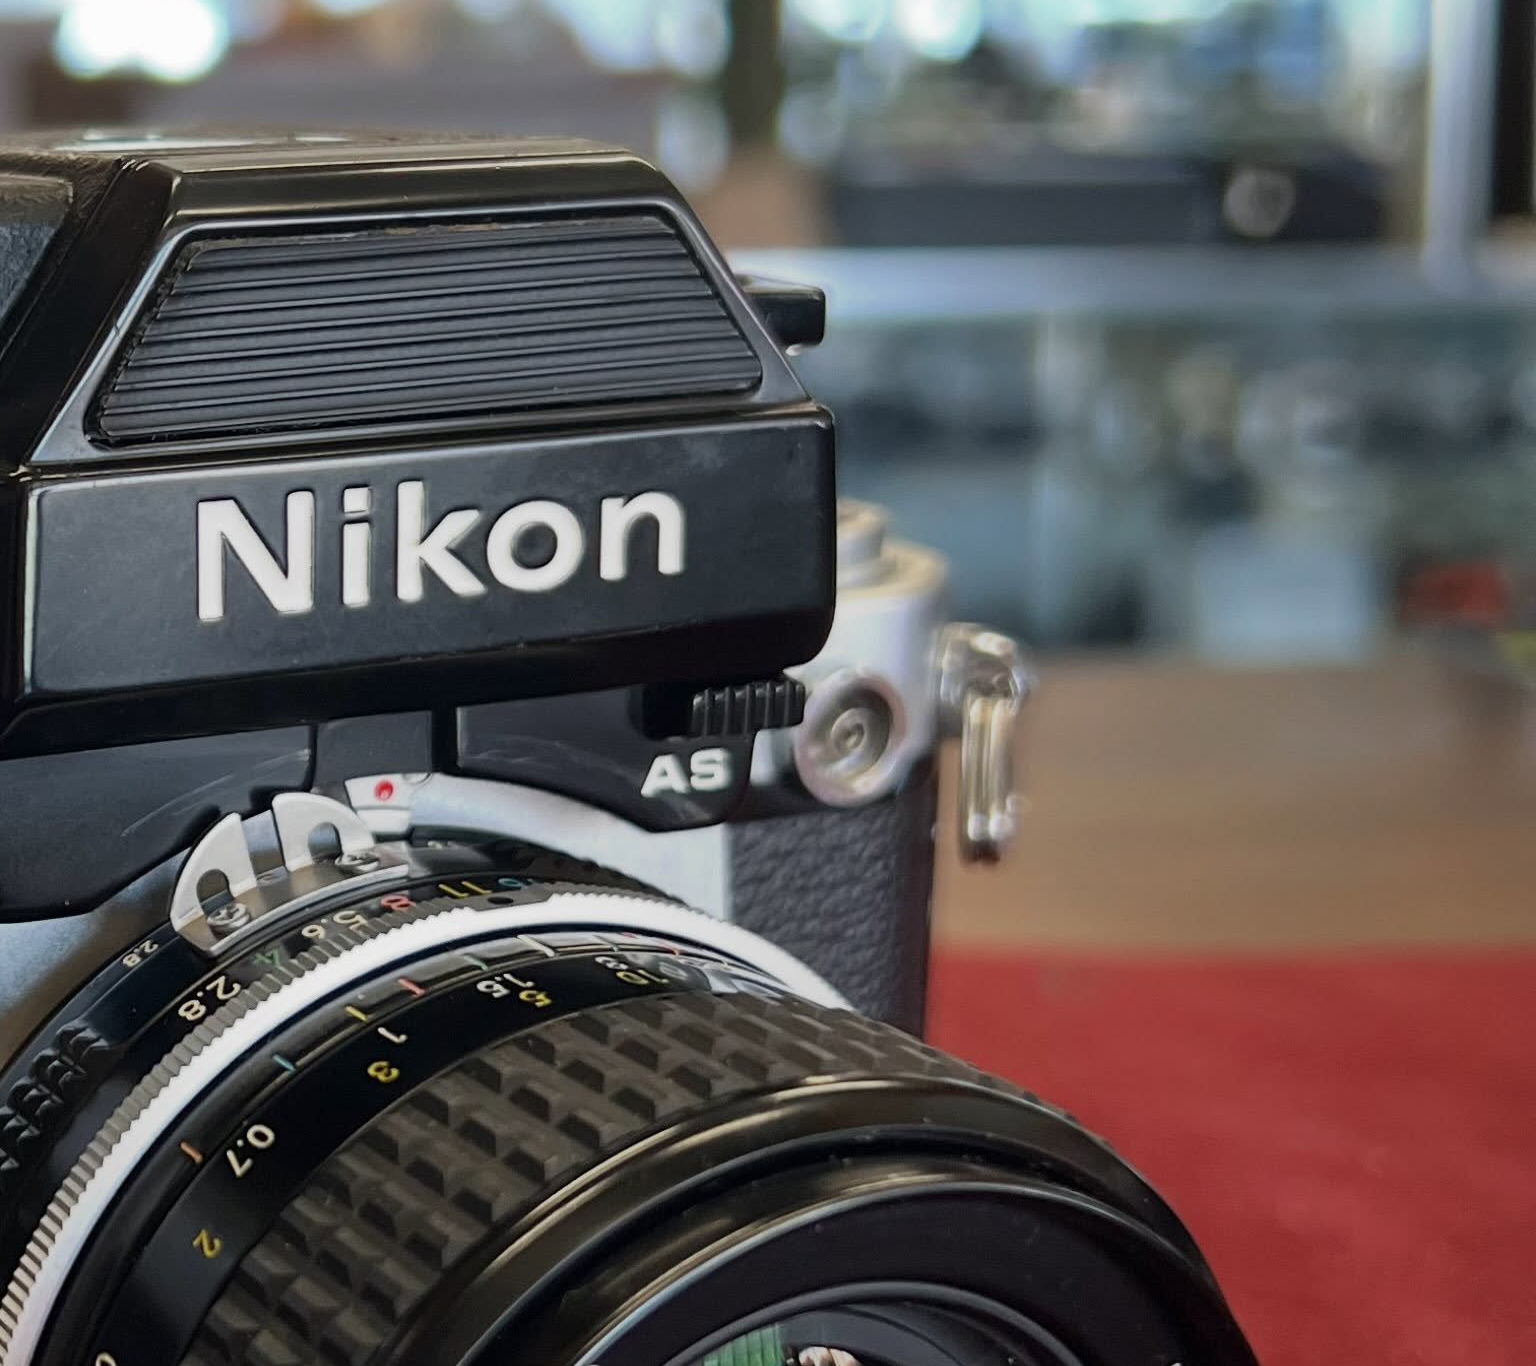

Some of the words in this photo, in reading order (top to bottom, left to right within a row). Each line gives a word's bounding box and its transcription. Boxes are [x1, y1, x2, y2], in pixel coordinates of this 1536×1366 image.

[196, 481, 686, 623] Nikon
[641, 747, 734, 797] AS
[123, 940, 158, 967] 2.8
[178, 976, 241, 1021] 2.8
[300, 910, 368, 941] 5.6
[380, 894, 415, 912] 8
[439, 880, 491, 898] 11
[192, 1229, 222, 1259] 2
[368, 1061, 399, 1083] 3
[517, 988, 552, 1008] 5
[616, 969, 669, 986] 10
[225, 1123, 275, 1178] 0.7
[376, 1026, 407, 1046] 1
[476, 973, 534, 999] 1.5
